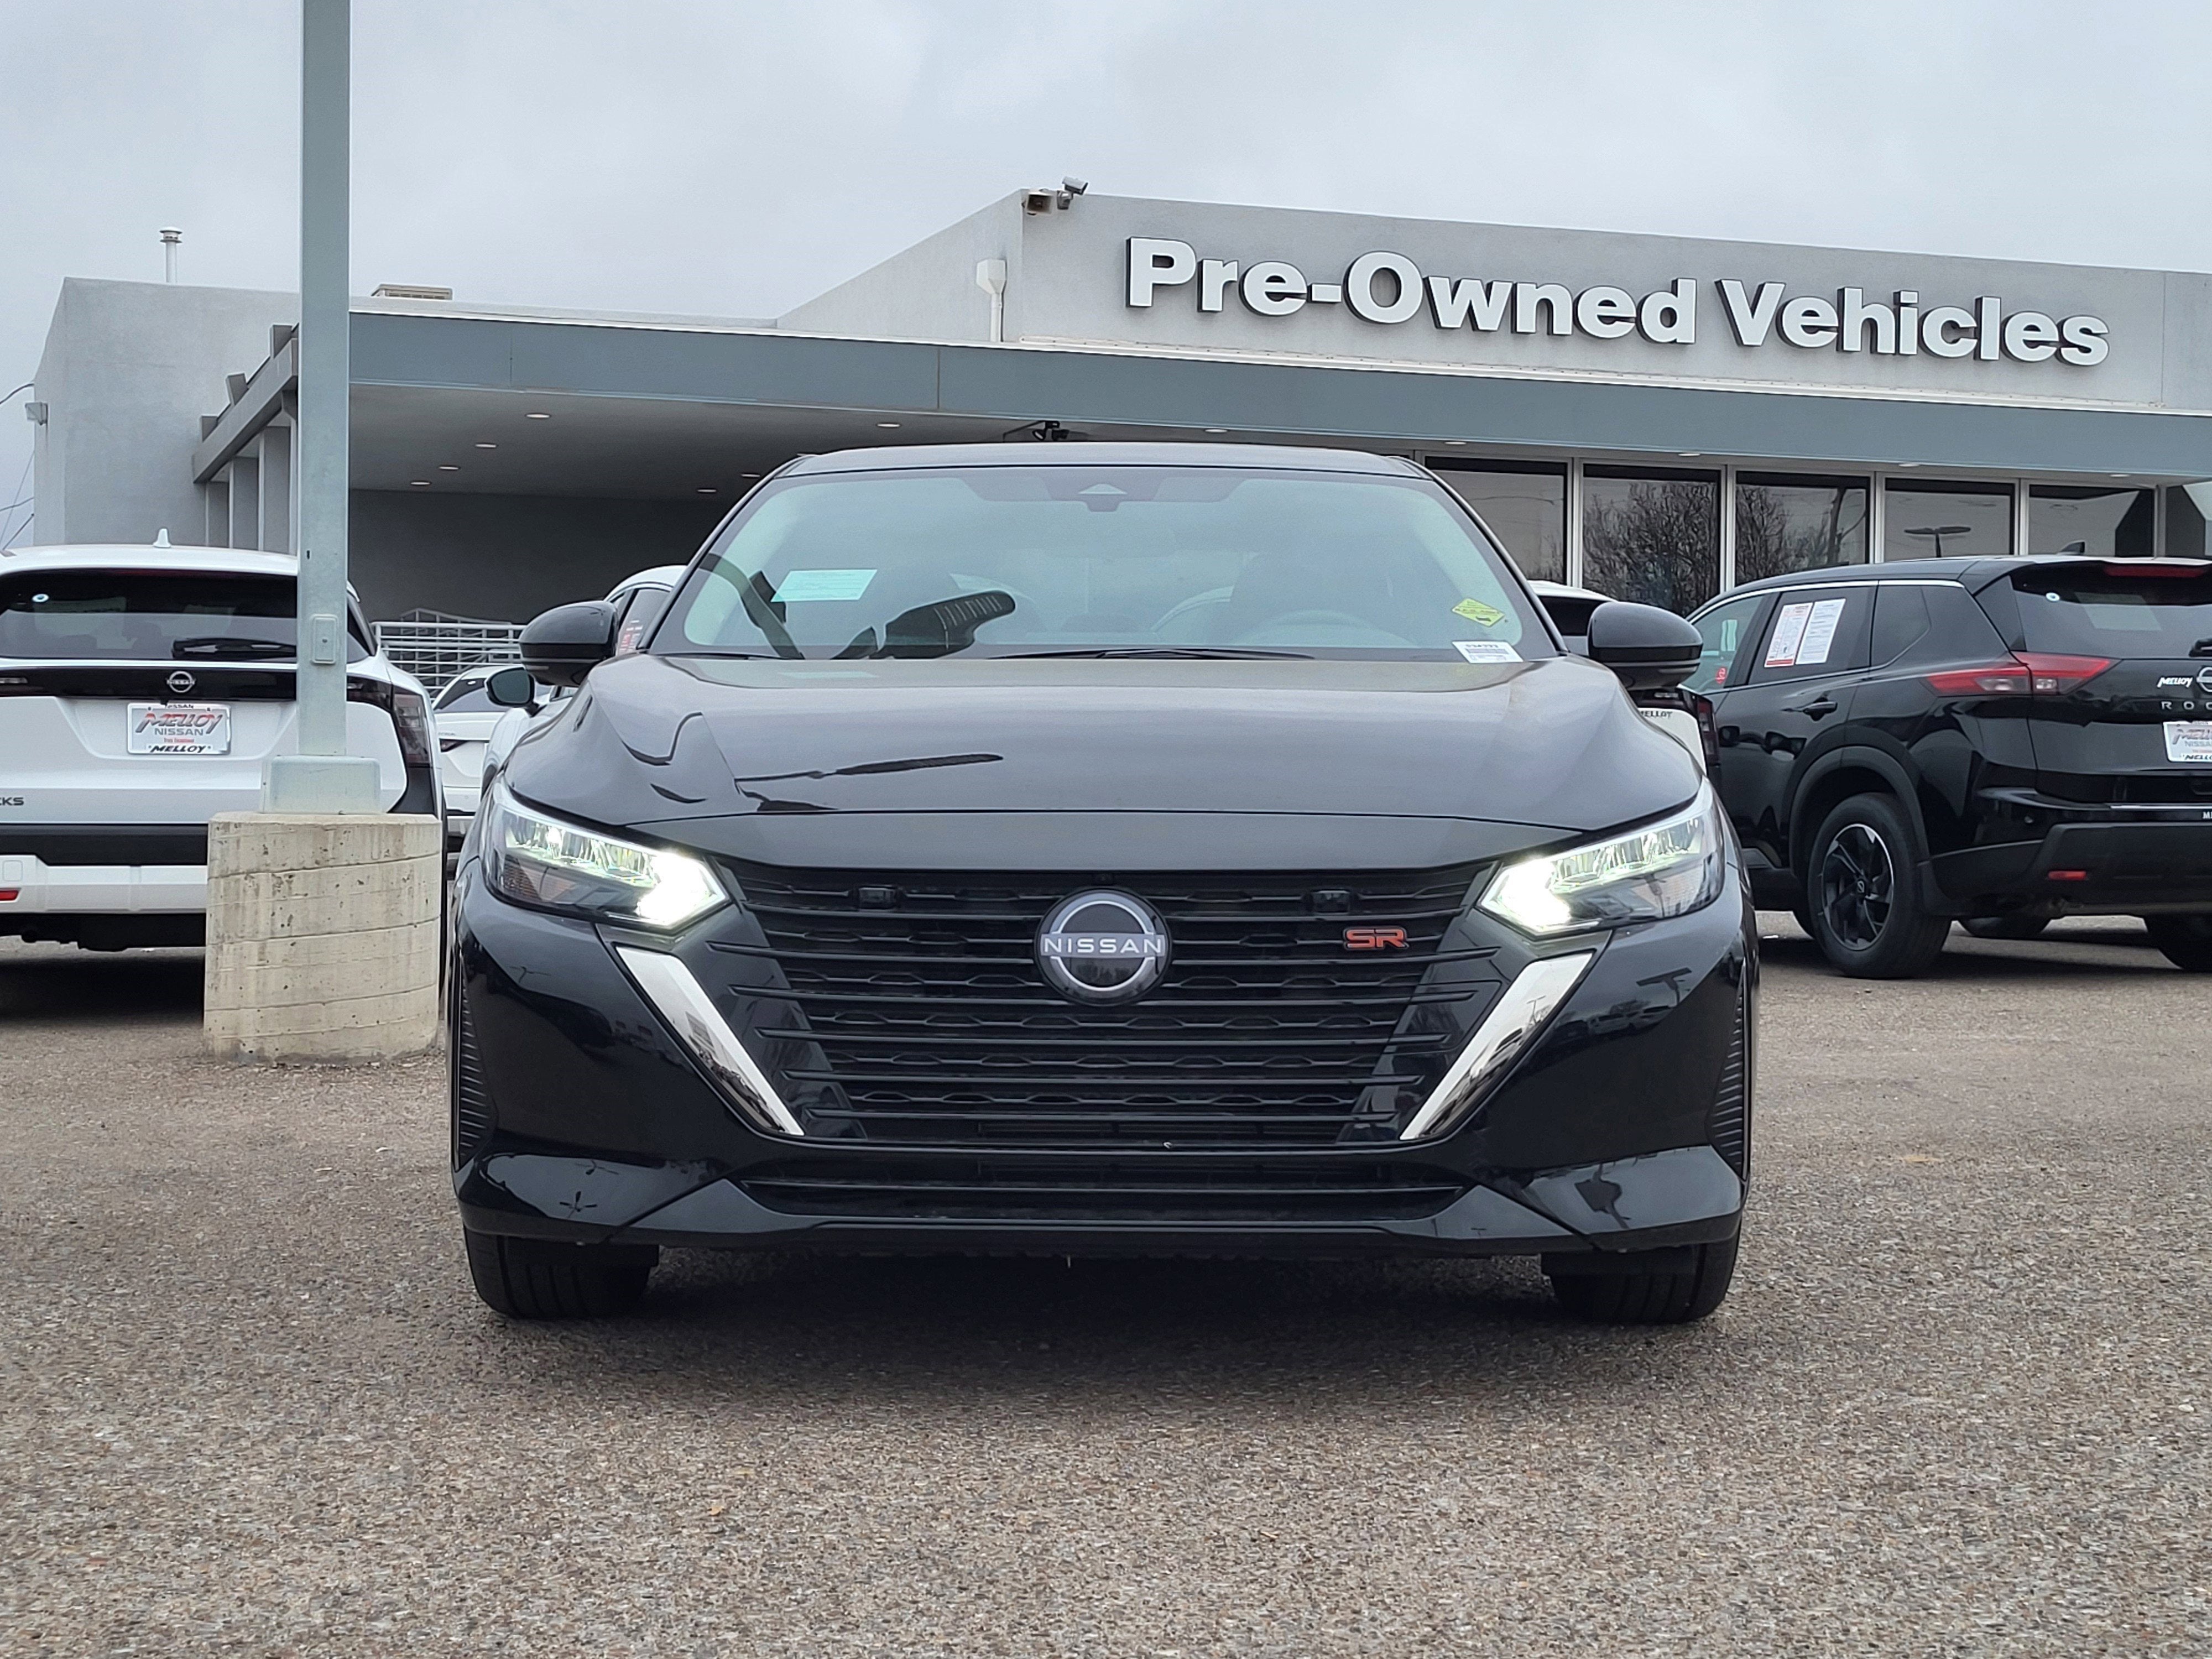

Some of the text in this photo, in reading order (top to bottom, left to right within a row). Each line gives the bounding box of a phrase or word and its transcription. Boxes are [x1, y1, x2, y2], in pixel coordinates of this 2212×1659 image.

[1126, 237, 2110, 366] Pre-Owned Vehicles
[2157, 677, 2193, 687] MELLOY
[135, 713, 223, 734] MELLOY
[150, 745, 206, 753] MELLOY
[0, 797, 24, 806] KS
[1044, 938, 1161, 953] NISSAN
[1346, 929, 1406, 948] SR
